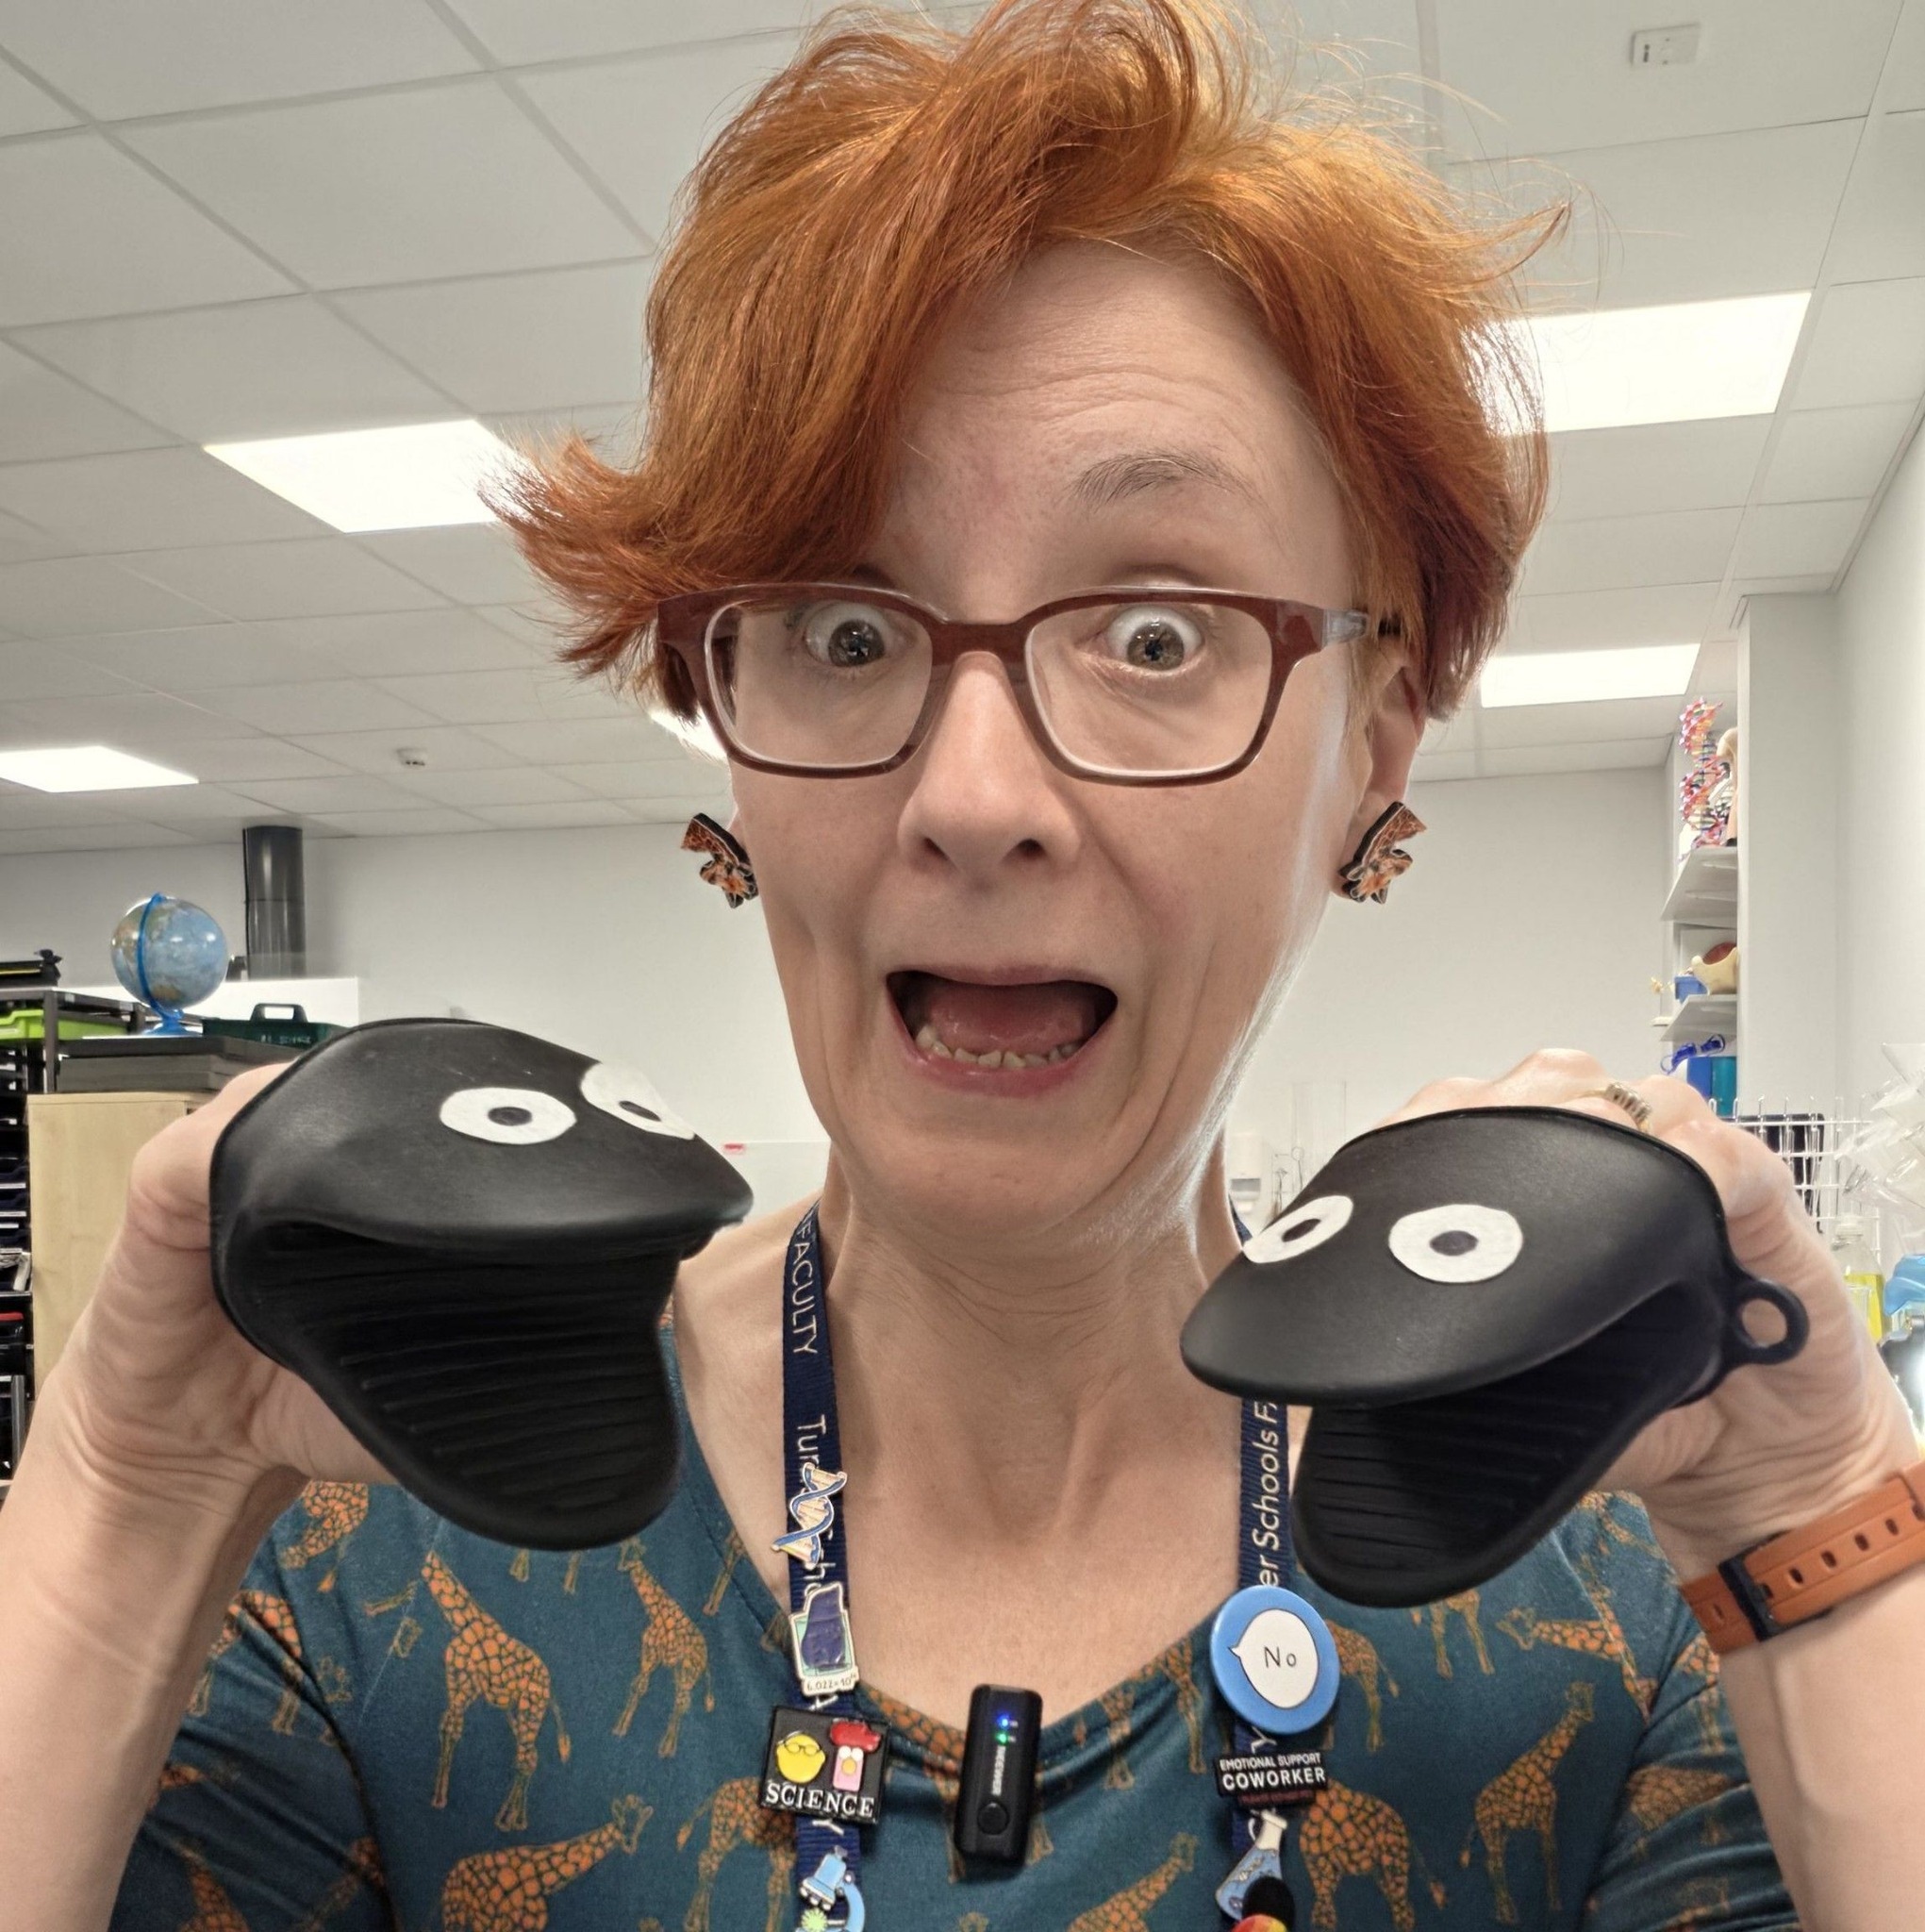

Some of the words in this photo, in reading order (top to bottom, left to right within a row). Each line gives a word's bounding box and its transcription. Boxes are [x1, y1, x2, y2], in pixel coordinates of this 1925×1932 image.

[792, 1221, 818, 1354] FACULTY
[1252, 1429, 1280, 1550] Schools
[1264, 1646, 1297, 1668] No
[1220, 1757, 1276, 1771] EMOTIONAL
[1277, 1753, 1320, 1767] SUPPORT
[1222, 1767, 1325, 1790] COWORKER
[765, 1782, 875, 1818] SCIENCE
